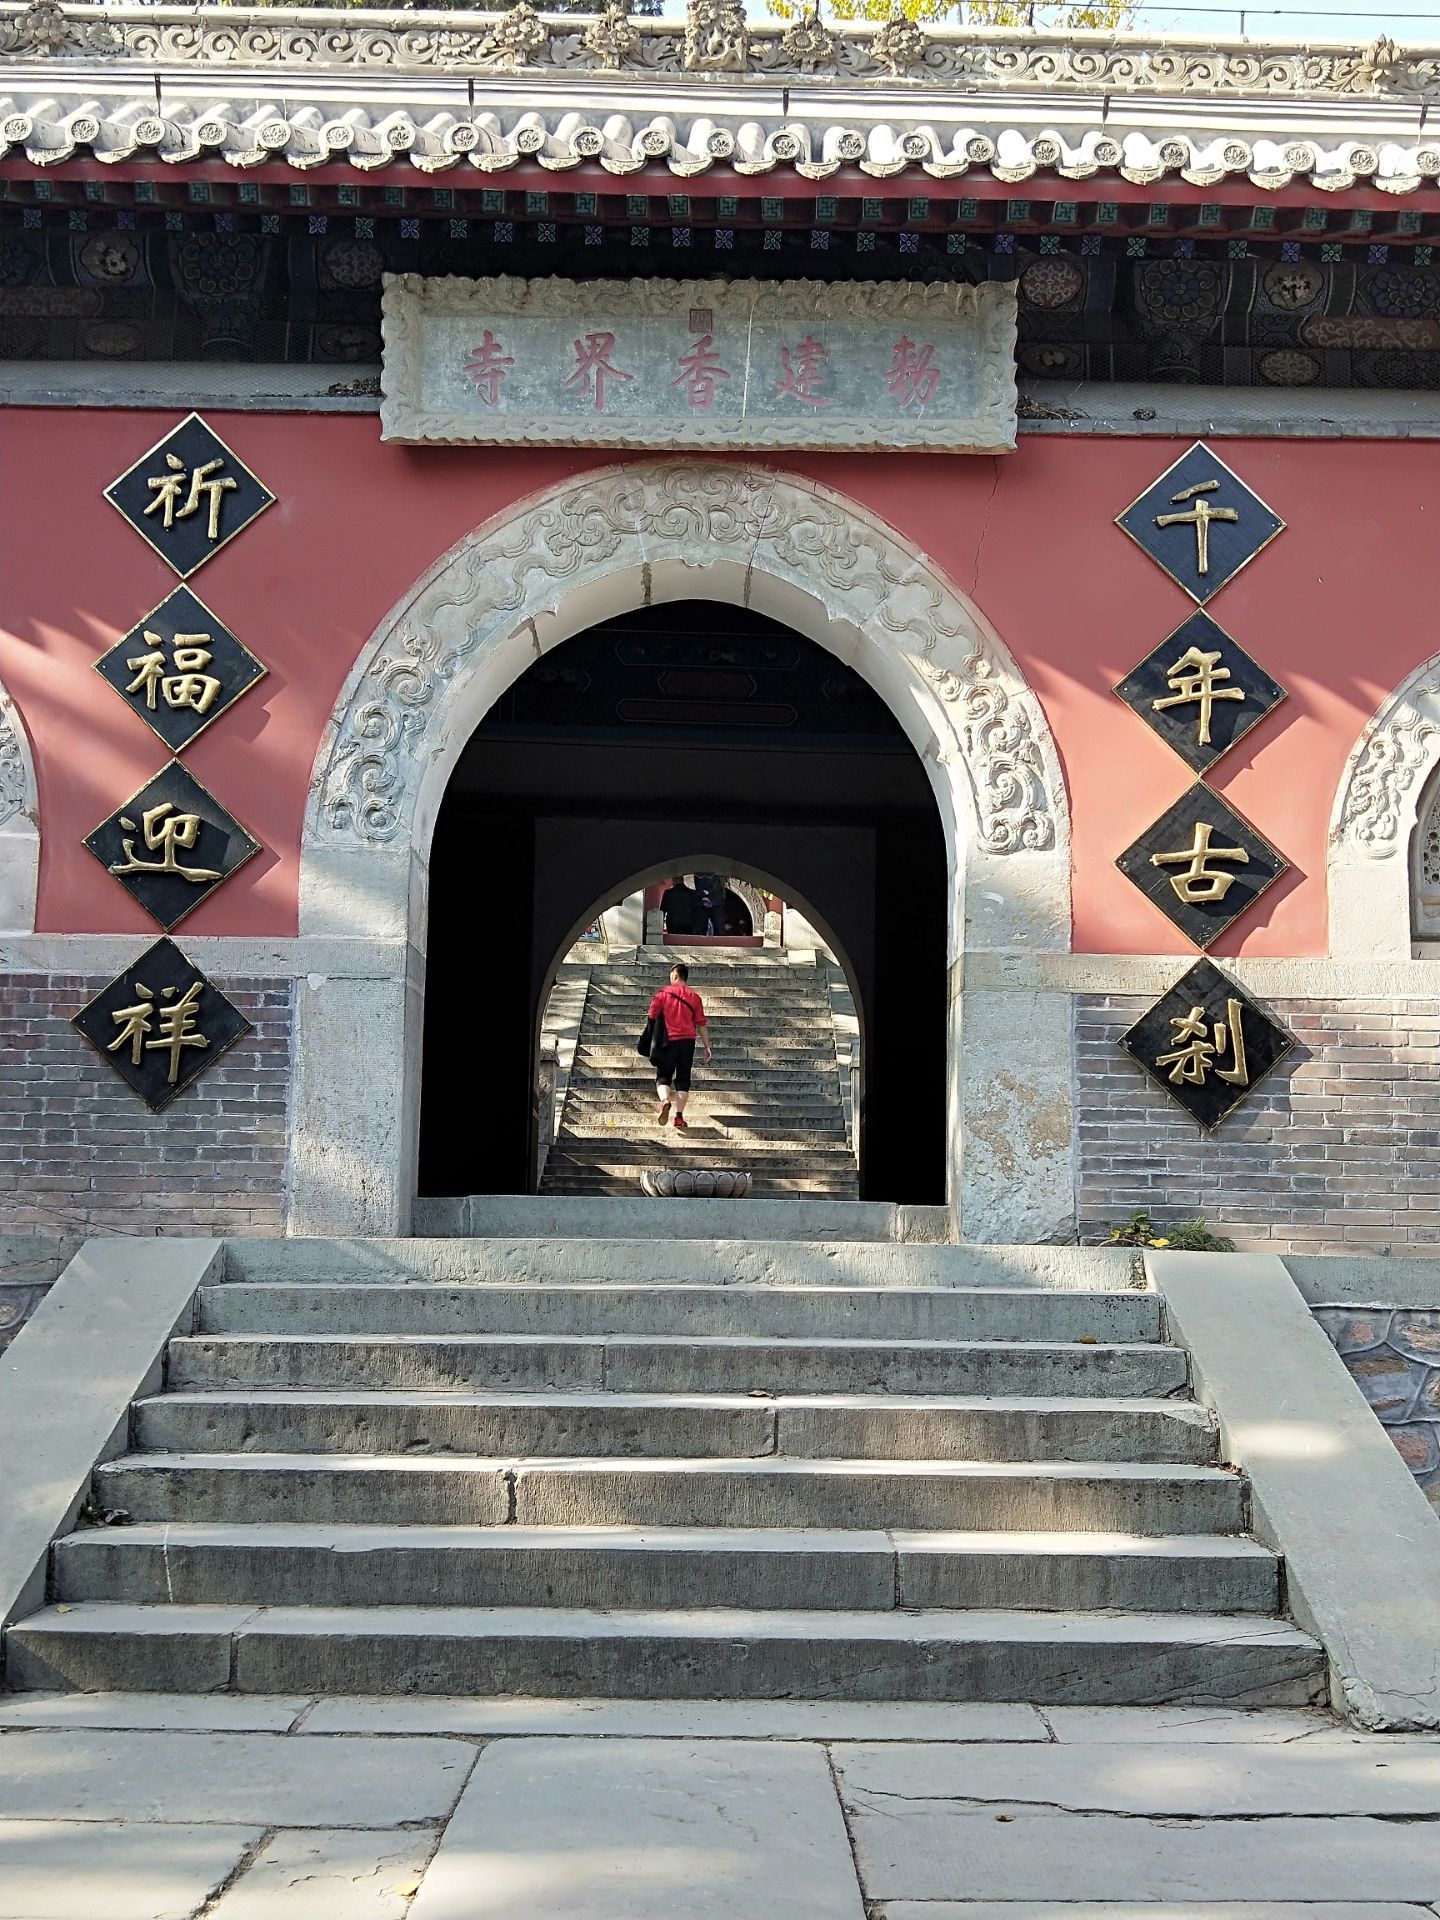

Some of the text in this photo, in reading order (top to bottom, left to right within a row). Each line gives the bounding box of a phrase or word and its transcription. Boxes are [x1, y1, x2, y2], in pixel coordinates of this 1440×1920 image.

[107, 453, 237, 1083] 祈福迎祥
[1152, 479, 1250, 1087] 千年古刹
